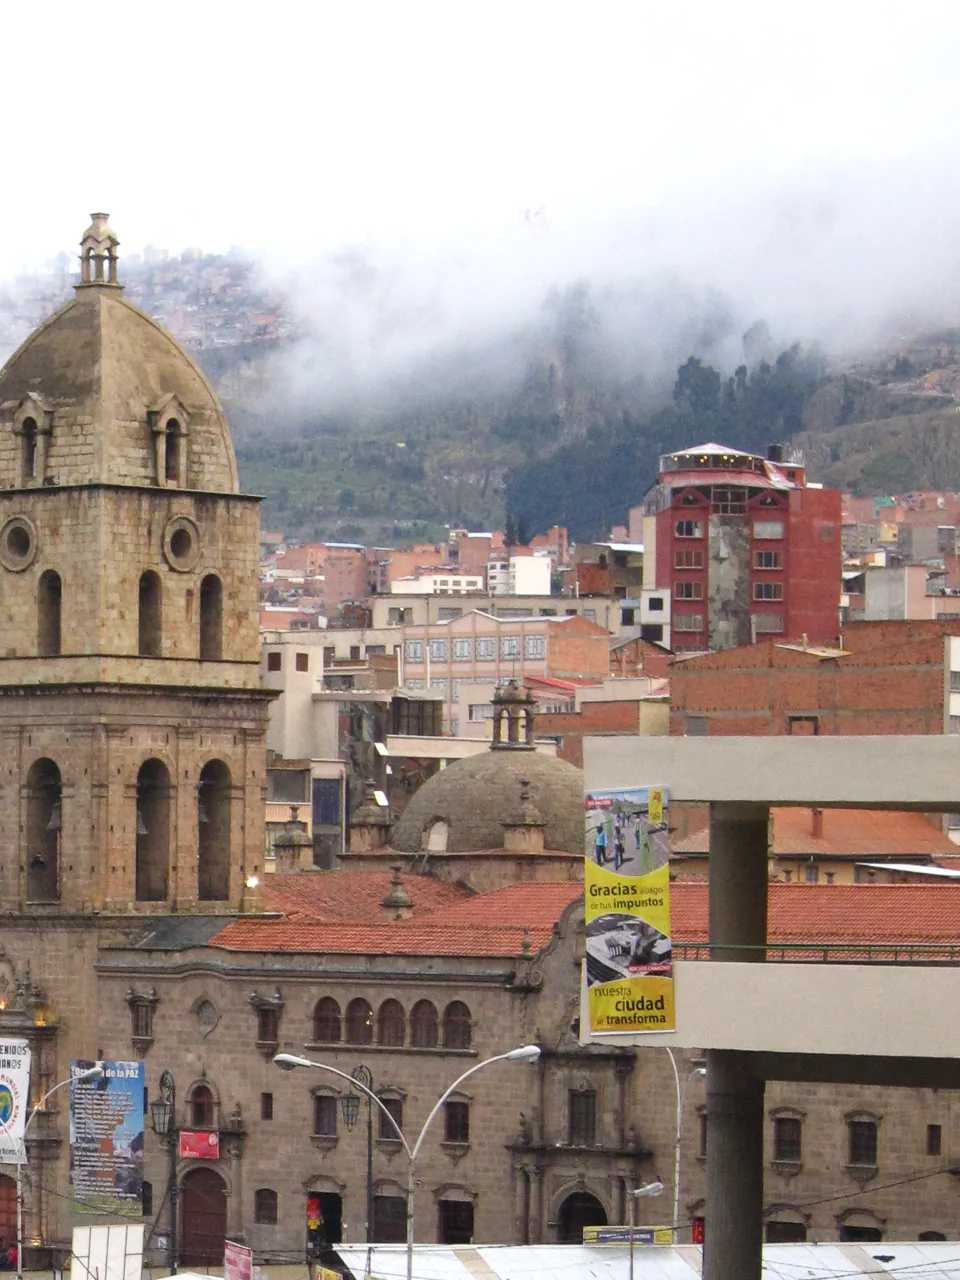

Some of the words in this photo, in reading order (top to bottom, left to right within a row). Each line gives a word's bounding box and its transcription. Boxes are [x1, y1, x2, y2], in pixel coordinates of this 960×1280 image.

[589, 882, 638, 897] Gracias
[599, 902, 611, 910] tus
[613, 898, 664, 911] impuestos
[594, 986, 632, 997] nuestra
[615, 995, 665, 1012] ciudad
[606, 1012, 666, 1025] transforma
[106, 1068, 116, 1077] de
[117, 1068, 124, 1078] la
[125, 1069, 139, 1079] PAZ
